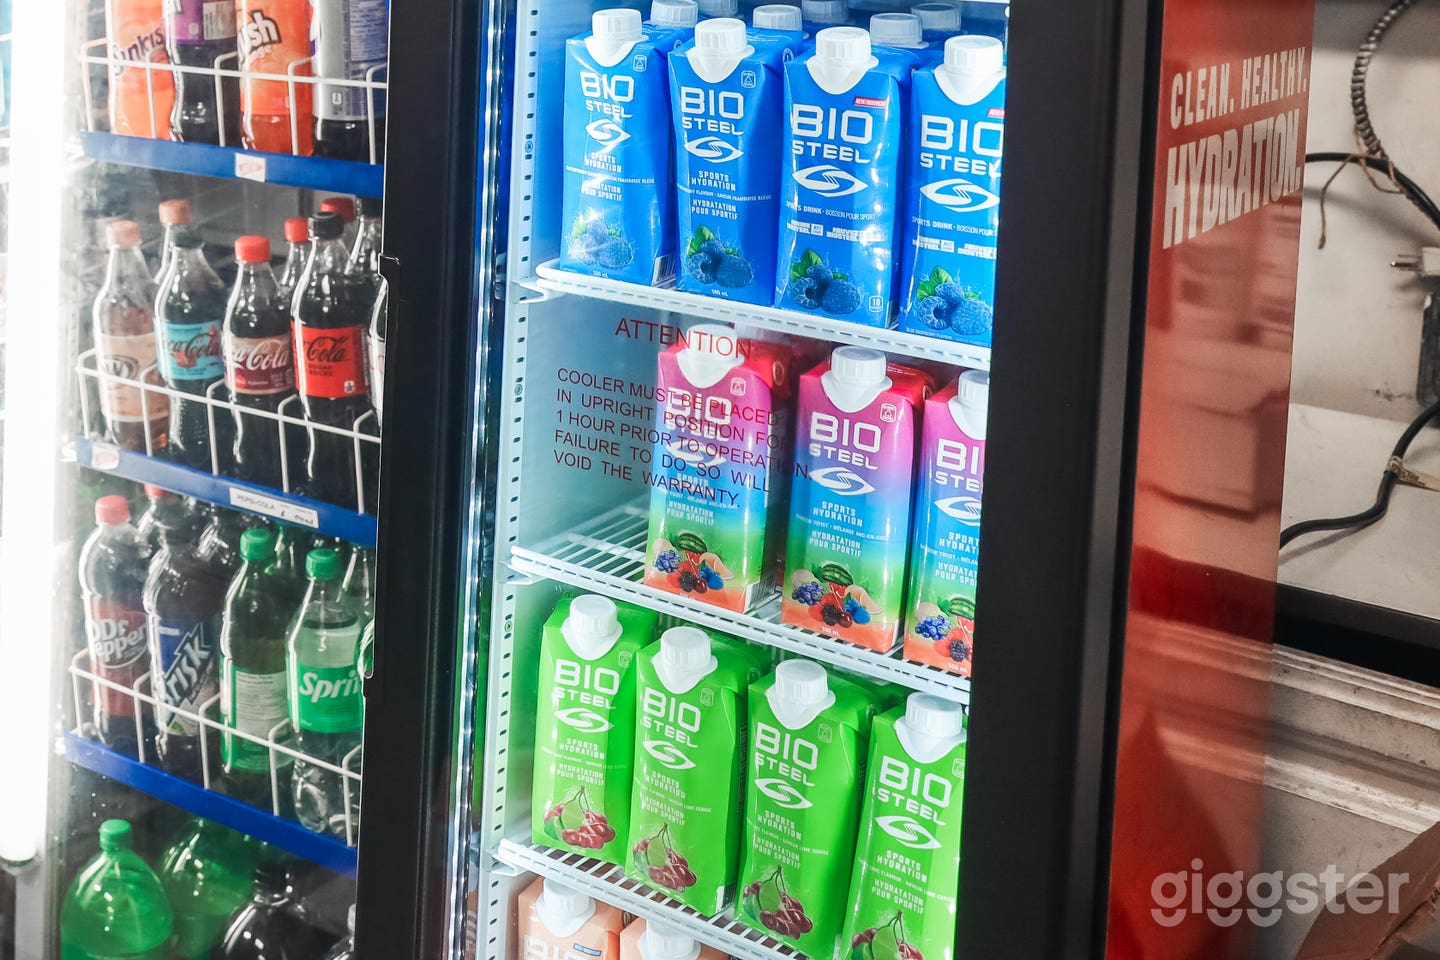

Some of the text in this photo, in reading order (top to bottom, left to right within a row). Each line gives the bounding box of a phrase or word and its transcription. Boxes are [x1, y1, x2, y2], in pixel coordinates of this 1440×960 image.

[113, 28, 165, 76] Sunkis
[579, 71, 635, 103] BIO
[1171, 47, 1307, 129] CLEAN. HEALTHY.
[585, 99, 633, 118] STEEL
[680, 86, 744, 120] BIO
[681, 116, 744, 136] STEEL
[792, 103, 873, 144] BIO
[921, 115, 1004, 157] BIO
[591, 152, 615, 164] SPORTS
[792, 139, 871, 164] STEEL
[585, 157, 622, 173] HYDRATION
[698, 171, 730, 182] SPORTS
[920, 152, 1002, 178] STEEL
[691, 177, 736, 191] HYDRATION
[1163, 108, 1300, 250] HYDRATION.
[691, 207, 738, 221] POUR SPORTIF
[692, 199, 737, 212] HYDRATATION
[803, 205, 822, 214] DRINK
[933, 221, 953, 231] DRINK
[871, 298, 881, 307] 10
[615, 318, 751, 359] ATTENTION
[558, 368, 779, 426] COOLER MUST BE PLACED
[665, 387, 732, 425] BIO
[557, 388, 785, 451] IN UPRIGHT POSITION FO
[810, 411, 882, 453] BIO
[557, 409, 813, 481] 1 HOUR PRIOR TO OPERATIN.
[809, 443, 879, 470] STEEL
[936, 438, 984, 475] BI
[555, 429, 620, 456] FAILURE
[630, 446, 652, 464] TO
[661, 454, 686, 472] DO
[696, 462, 721, 480] SO
[731, 471, 769, 493] WILL
[554, 450, 592, 470] VOID
[601, 460, 632, 481] THE
[642, 470, 741, 508] WARRANTY.
[935, 471, 982, 494] STE
[812, 507, 863, 527] HYDRATION
[822, 501, 856, 516] SPORTS
[812, 530, 861, 549] HYDRATATION
[831, 542, 862, 558] SPORTIF
[938, 538, 979, 554] HYDRATI
[948, 531, 979, 547] SPORT
[937, 561, 978, 579] HYDRATAT
[94, 627, 147, 663] epper
[165, 634, 211, 706] risk
[554, 658, 620, 696] BIO
[553, 686, 616, 710] STEEL
[643, 687, 701, 733] BIO
[566, 737, 598, 751] SPORTS
[641, 715, 699, 749] STEEL
[559, 743, 605, 760] HYDRATION
[756, 722, 819, 771] BIO
[652, 771, 680, 789] SPORTS
[755, 751, 816, 787] STEEL
[879, 755, 953, 809] BIO
[764, 810, 796, 830] SPORTS
[877, 788, 947, 826] STEEL
[757, 815, 802, 841] HYDRATION
[774, 852, 801, 870] SPORTIF
[877, 856, 928, 884] HYDRATION
[886, 850, 921, 871] SPORTS
[871, 887, 924, 915] POUR SPORTIF
[874, 879, 924, 905] HYDRATATION
